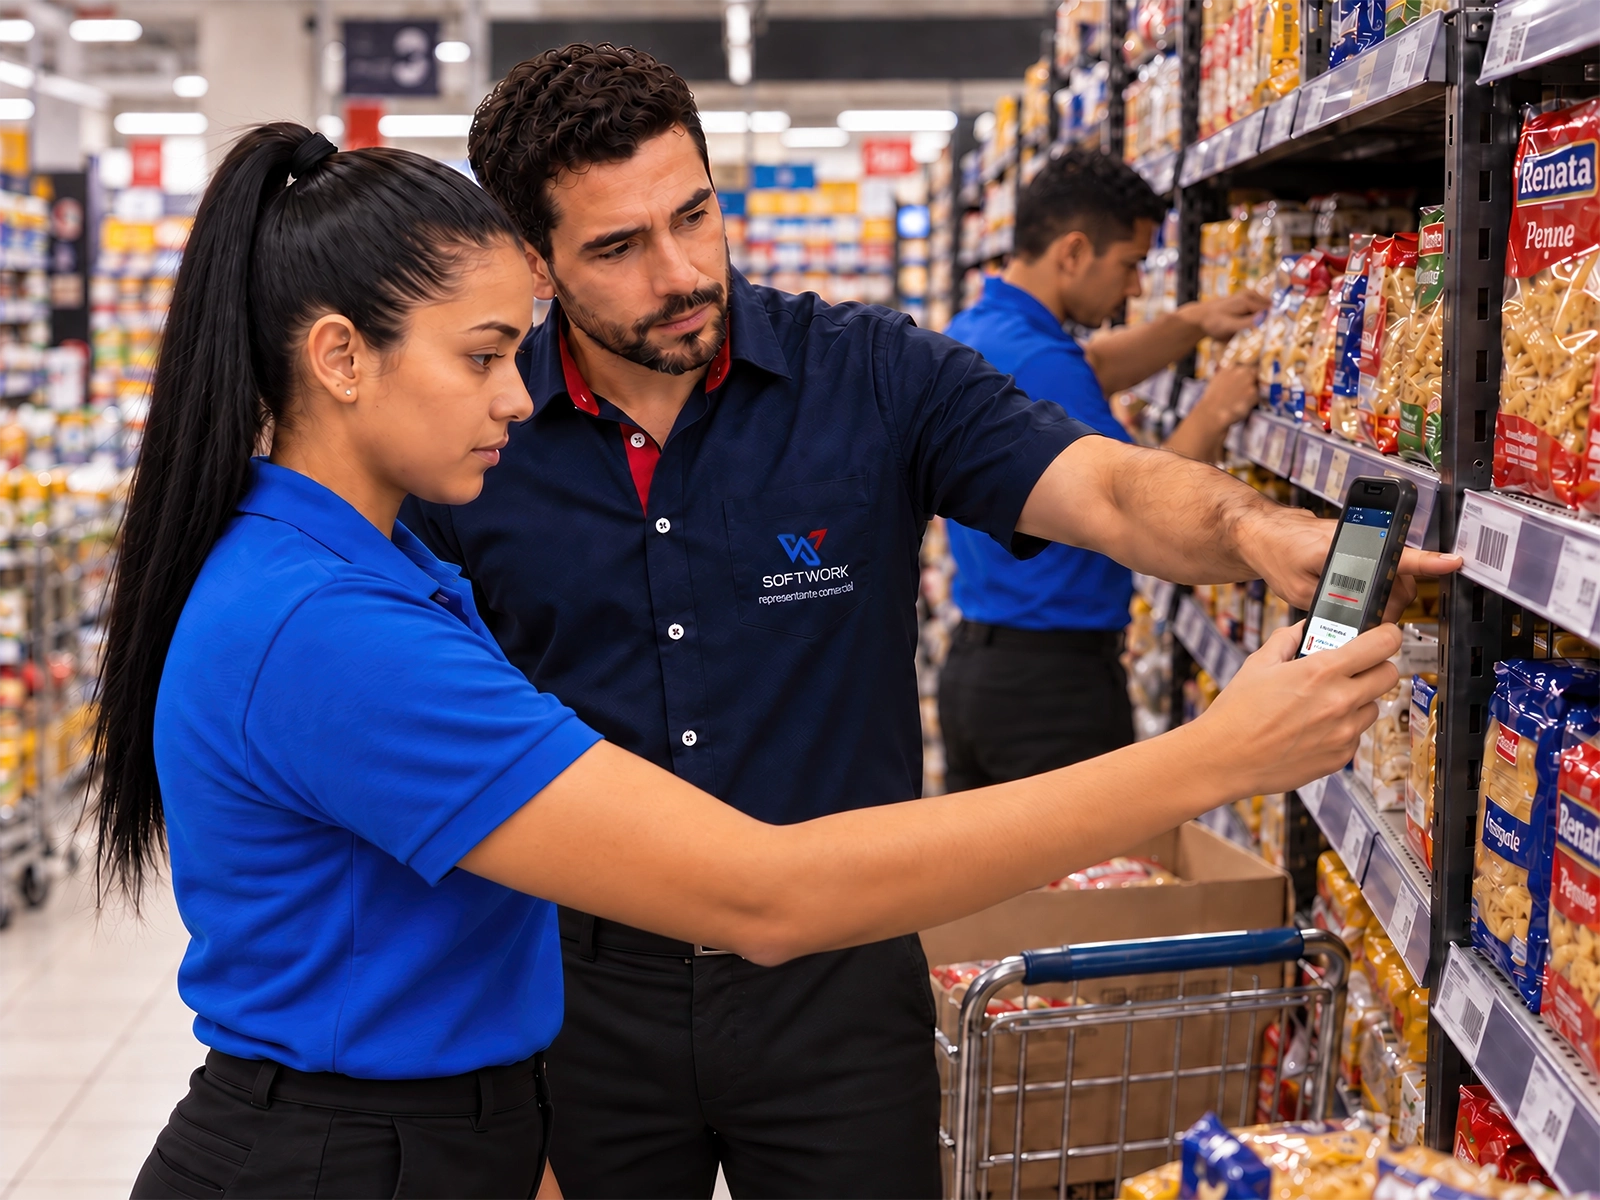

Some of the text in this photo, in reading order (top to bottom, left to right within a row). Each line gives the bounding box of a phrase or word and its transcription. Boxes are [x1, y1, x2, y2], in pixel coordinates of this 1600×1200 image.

[1521, 154, 1592, 194] Renata
[1525, 221, 1575, 249] Penne
[762, 564, 849, 588] SOFTWORK
[758, 581, 854, 605] representante comercial
[1558, 802, 1600, 860] Renat
